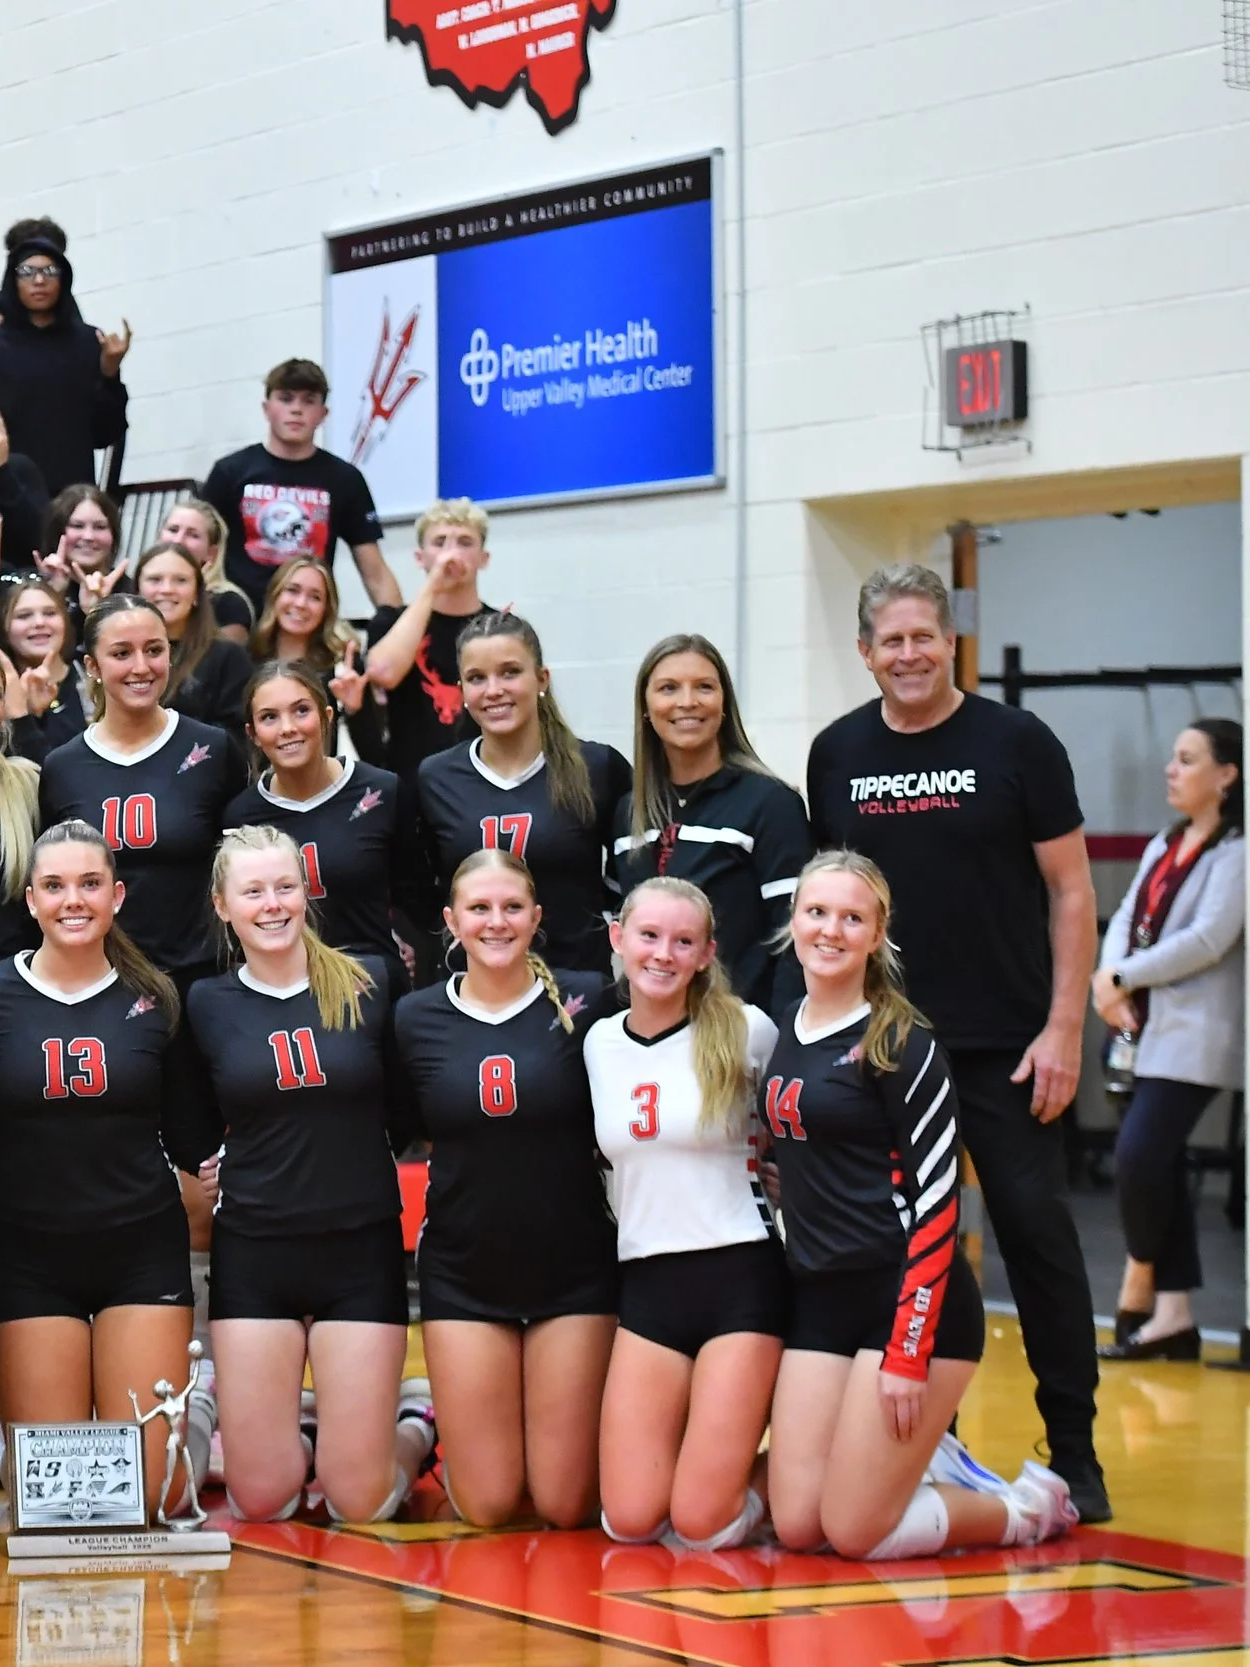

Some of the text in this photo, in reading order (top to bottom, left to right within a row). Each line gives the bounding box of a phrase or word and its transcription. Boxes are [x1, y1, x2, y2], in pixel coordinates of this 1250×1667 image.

[351, 176, 693, 259] PARTNERING TO BUILD A HEALTHIER COMMUNITY
[502, 317, 658, 379] Premier Health
[502, 362, 693, 416] Upper Valley Medical Center
[958, 348, 1001, 416] EXIT
[850, 769, 976, 802] TIPPECANOE
[858, 795, 960, 815] VOLLEYBALL
[102, 794, 156, 851] 10
[479, 812, 532, 864] 17
[300, 842, 327, 900] 1
[42, 1037, 107, 1099] 13
[269, 1028, 326, 1090] 11
[479, 1055, 516, 1117] 8
[630, 1082, 660, 1141] 3
[765, 1077, 807, 1140] 14
[30, 1438, 126, 1458] CHAMPION
[68, 1537, 109, 1545] LEAGUE
